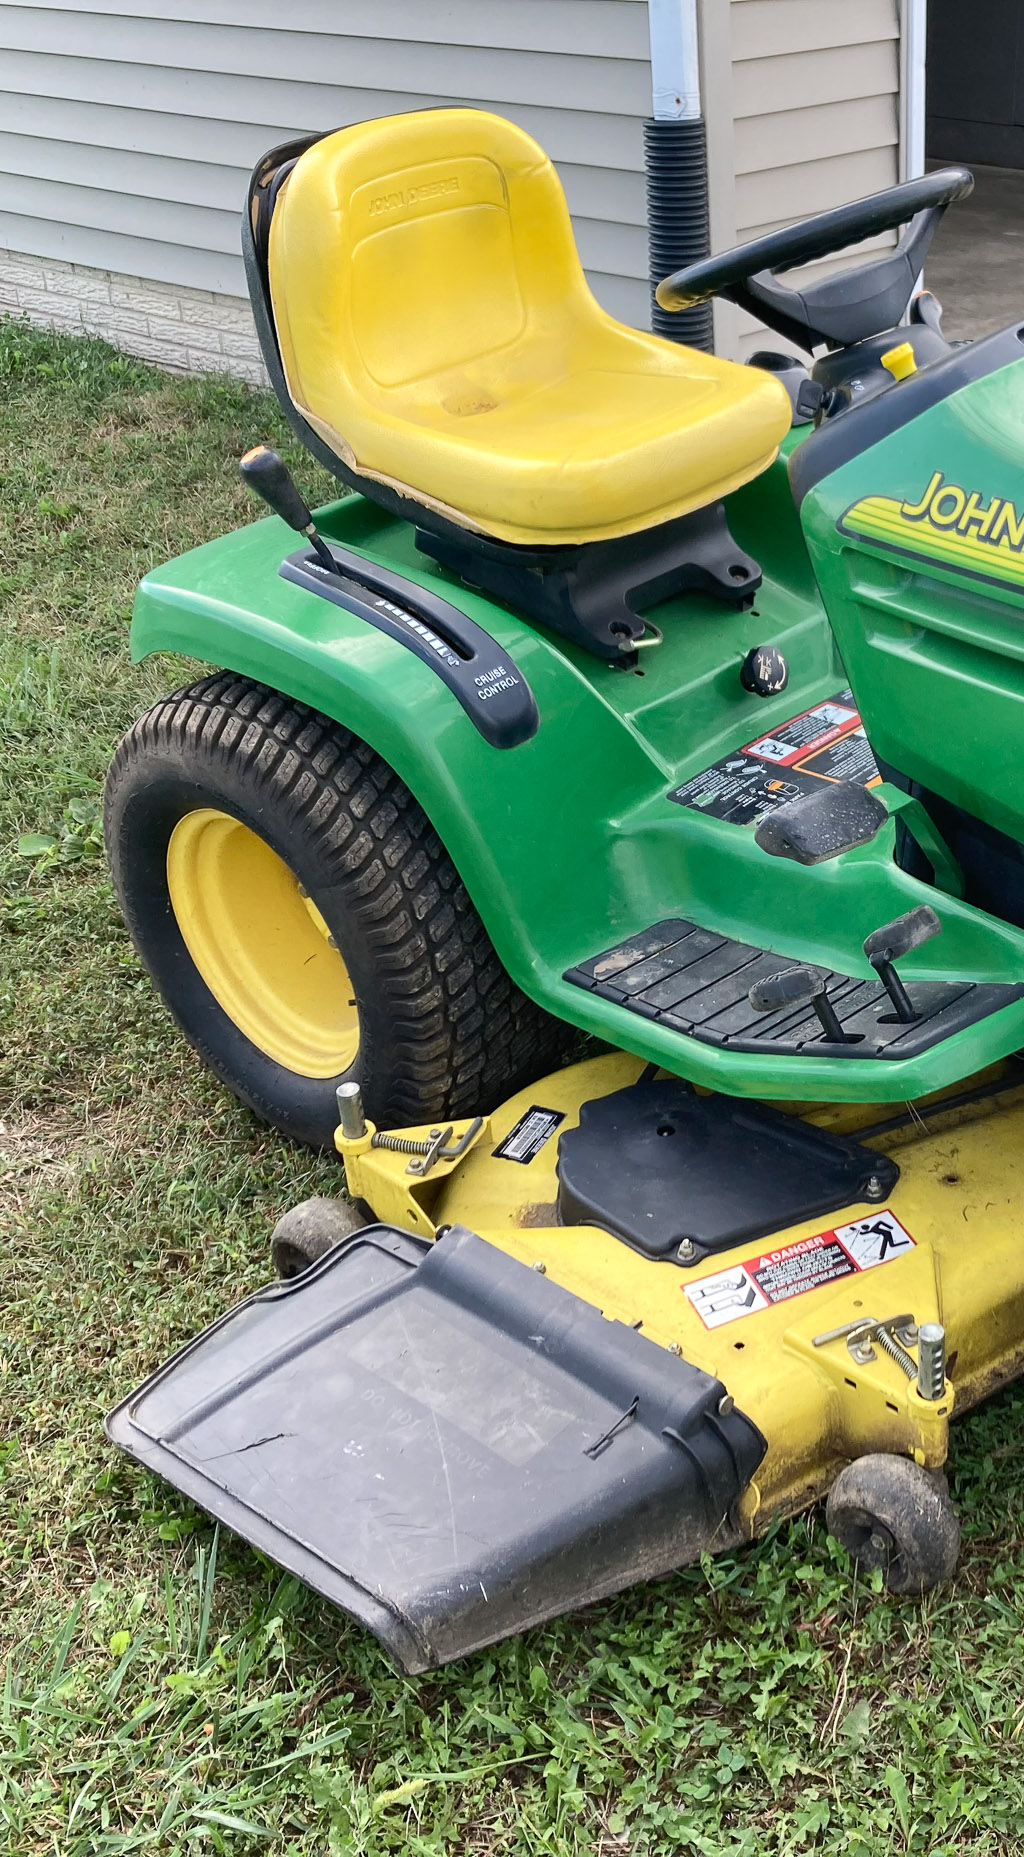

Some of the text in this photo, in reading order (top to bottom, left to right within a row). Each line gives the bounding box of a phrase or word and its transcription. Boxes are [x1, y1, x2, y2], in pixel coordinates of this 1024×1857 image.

[474, 665, 507, 687] CRUISE
[478, 675, 519, 700] CONTROL
[770, 1236, 824, 1262] DANGER
